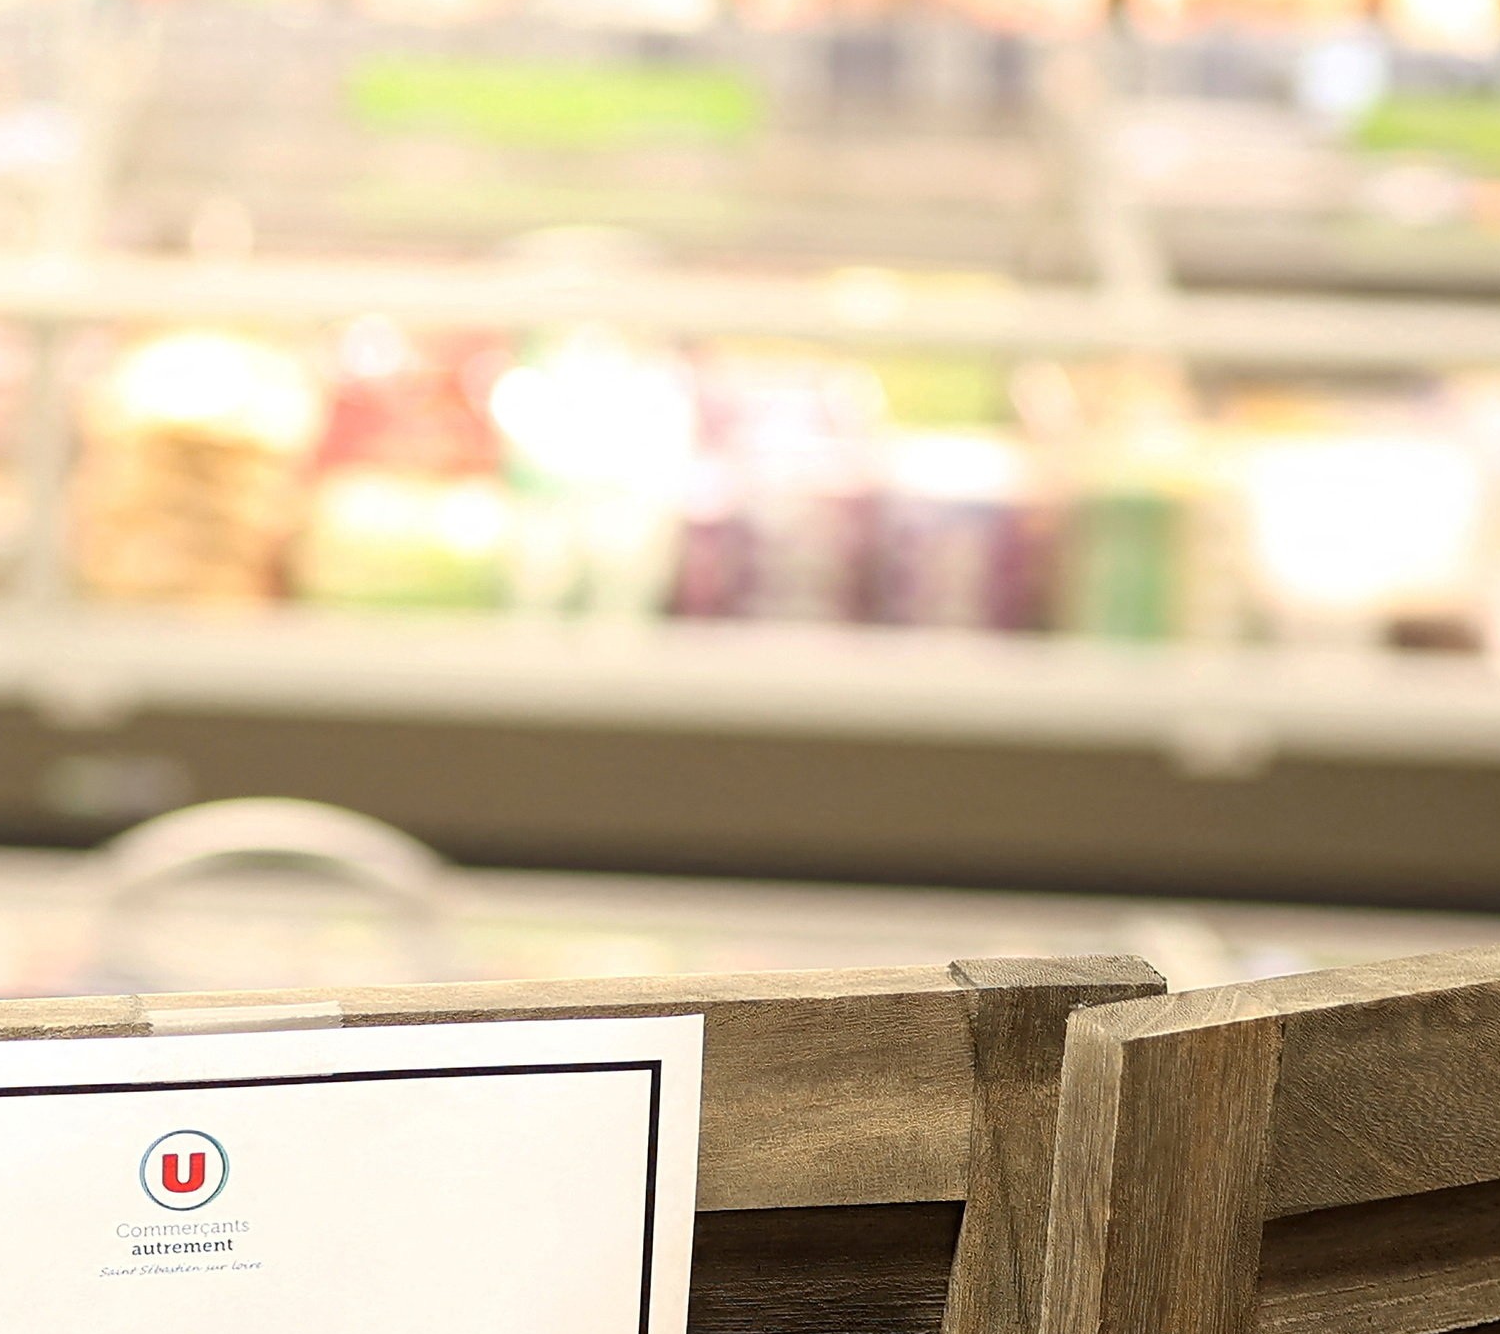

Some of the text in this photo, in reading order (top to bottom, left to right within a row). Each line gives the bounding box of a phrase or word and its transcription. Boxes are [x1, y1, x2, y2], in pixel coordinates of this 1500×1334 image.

[162, 1152, 206, 1193] U
[116, 1219, 250, 1238] Commerçants
[131, 1239, 234, 1256] autrement
